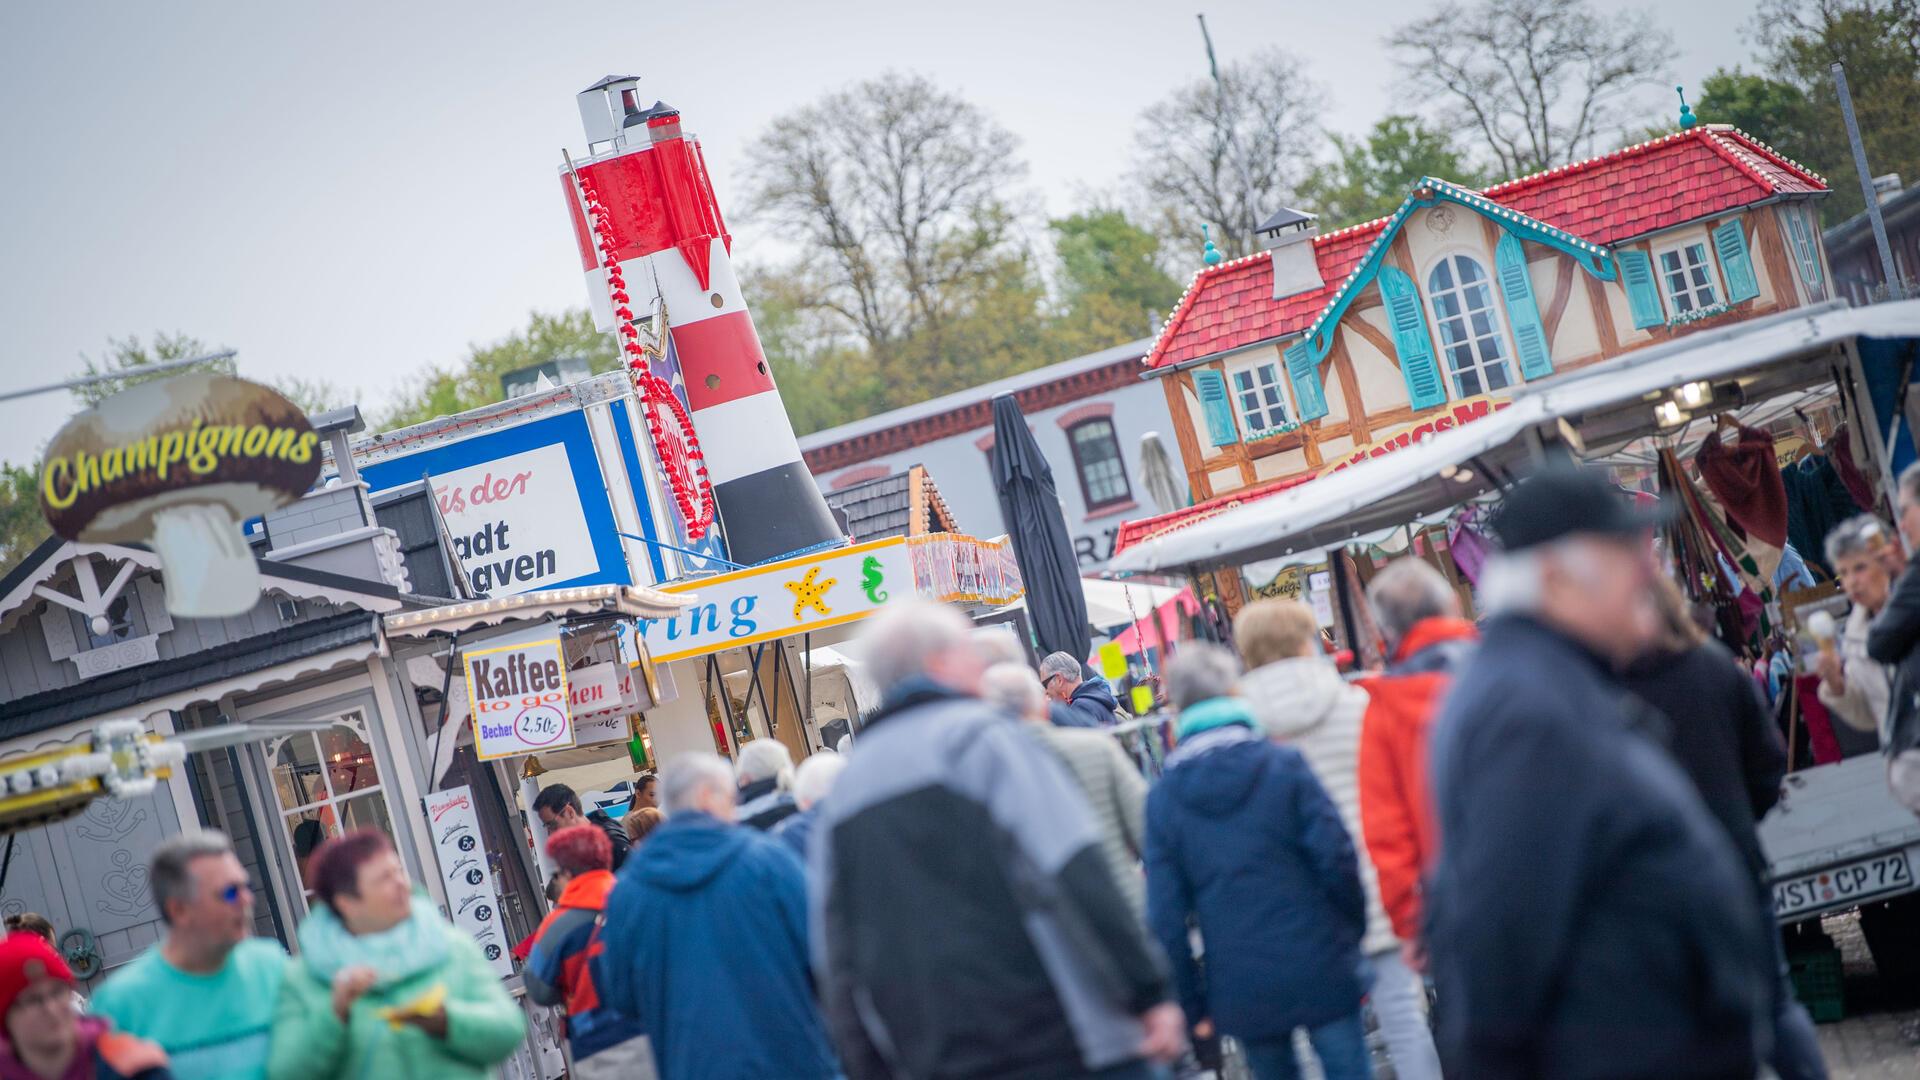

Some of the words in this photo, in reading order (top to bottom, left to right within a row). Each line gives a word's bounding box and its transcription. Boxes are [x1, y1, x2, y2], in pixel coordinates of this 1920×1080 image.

[44, 417, 319, 509] Champignons
[470, 472, 533, 506] der
[465, 548, 557, 593] aven
[472, 653, 561, 701] Kaffee
[479, 701, 511, 713] to
[521, 692, 562, 709] go
[482, 723, 513, 740] Becher
[1835, 866, 1868, 894] CP
[1872, 857, 1907, 885] 72
